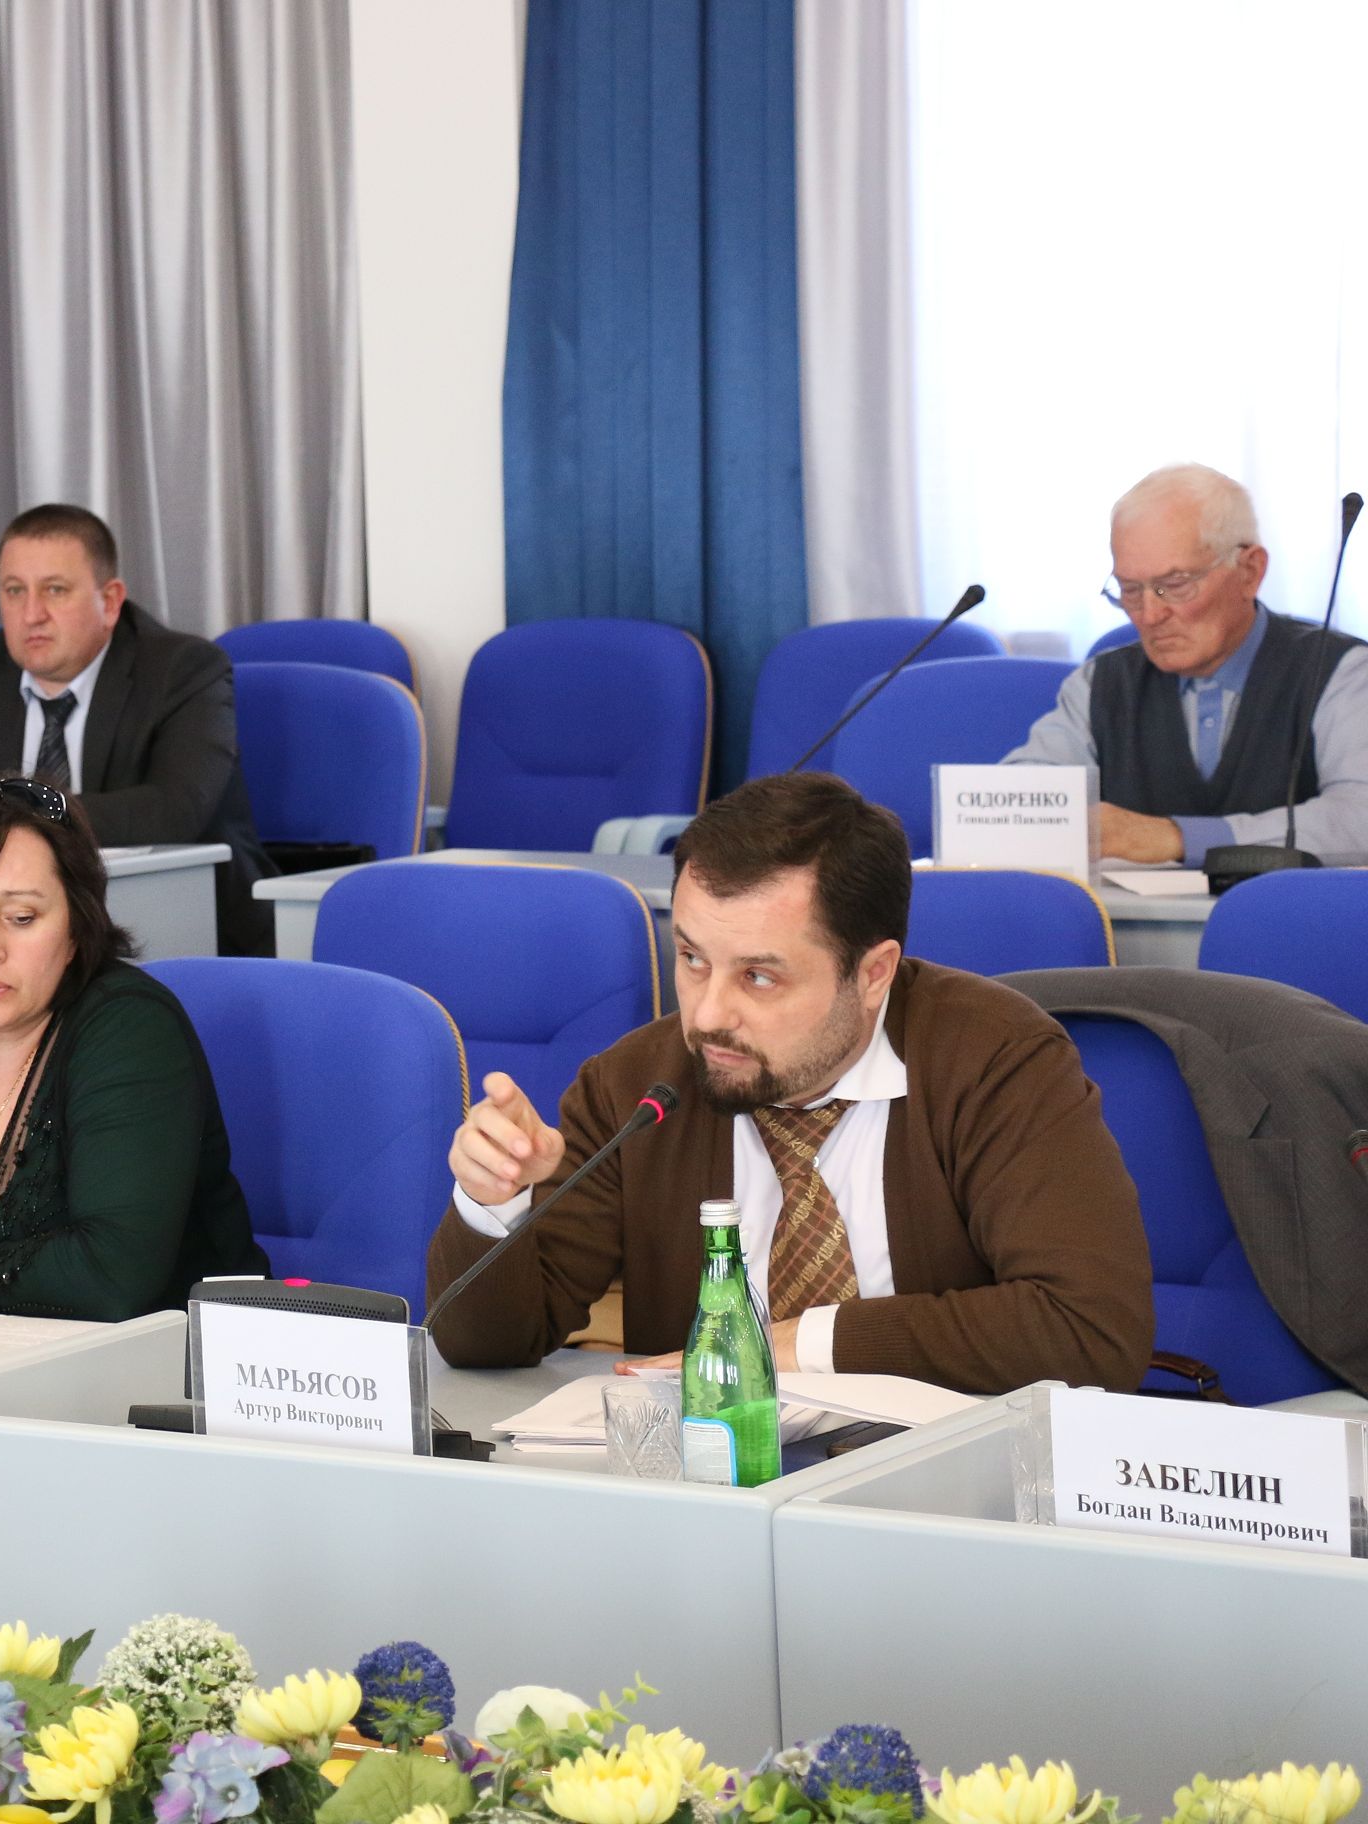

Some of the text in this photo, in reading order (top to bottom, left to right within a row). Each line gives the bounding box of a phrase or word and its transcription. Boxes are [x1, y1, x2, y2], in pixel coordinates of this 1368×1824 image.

[957, 792, 1068, 808] СИДОРЕНКО
[957, 814, 1069, 824] Геннадий Павлович
[235, 1363, 378, 1401] МАРЬЯСОВ
[234, 1398, 383, 1431] Артур Викторович
[1114, 1458, 1283, 1504] ЗАБЕЛИН
[1076, 1493, 1329, 1544] Богдан Владимирович
